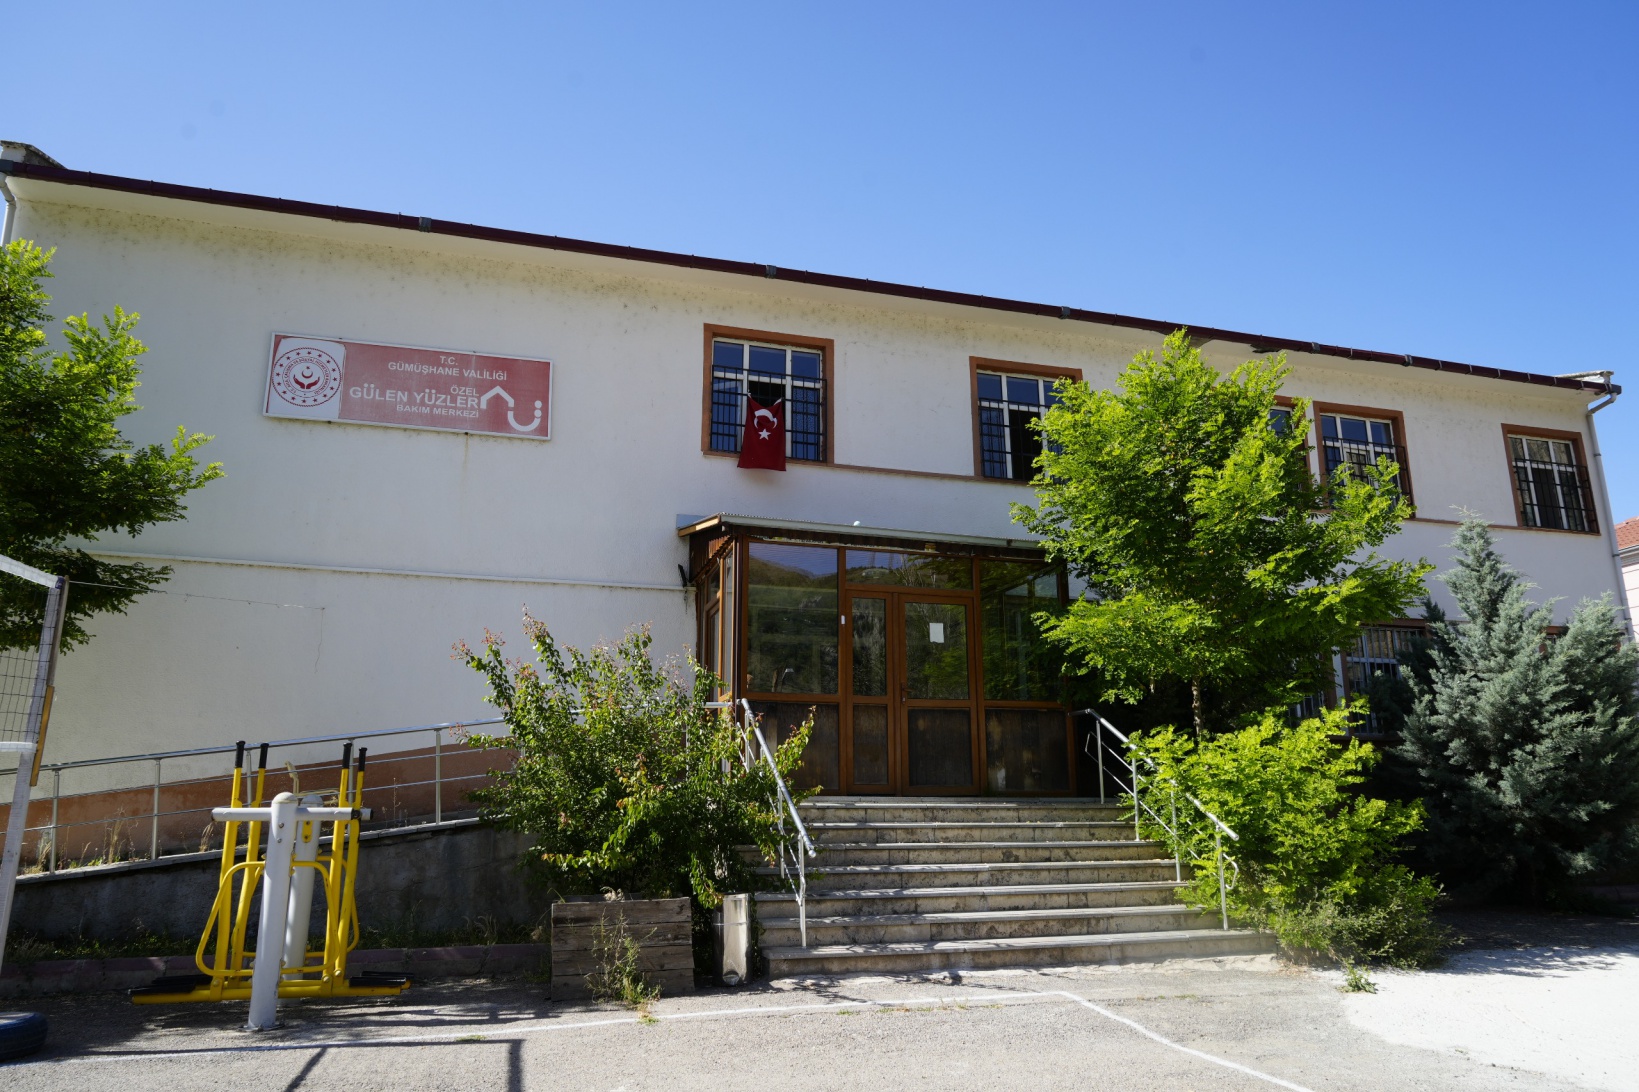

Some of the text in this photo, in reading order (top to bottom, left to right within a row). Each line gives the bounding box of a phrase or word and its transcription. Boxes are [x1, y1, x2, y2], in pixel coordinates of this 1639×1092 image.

[440, 355, 458, 366] T.C.
[388, 361, 507, 381] GÜMÜŞHANE VALİLİĞİ
[349, 383, 479, 409] GÜLEN YÜZLER
[450, 384, 480, 397] ÖZEL
[396, 404, 479, 418] BAKIM MERKEZİ
